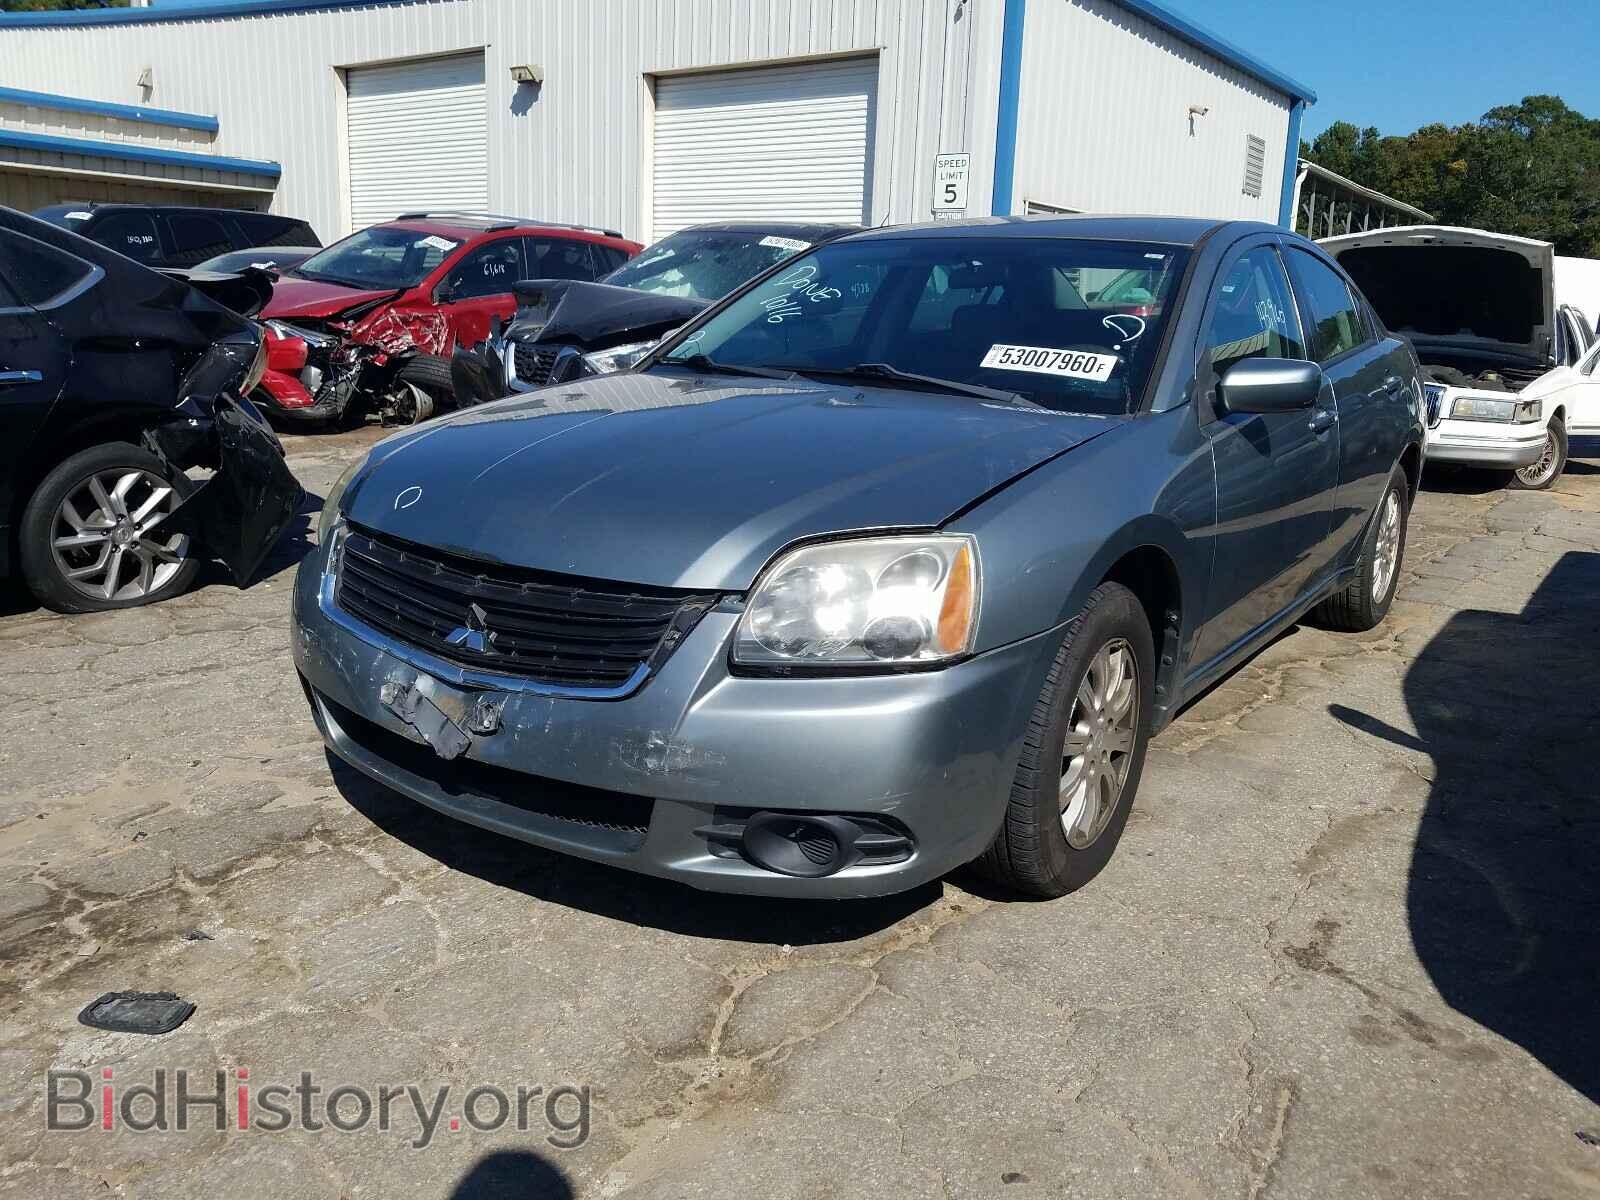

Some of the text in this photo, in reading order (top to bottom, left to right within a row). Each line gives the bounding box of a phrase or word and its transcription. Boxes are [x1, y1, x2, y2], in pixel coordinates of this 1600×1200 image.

[938, 159, 967, 168] SPEED
[940, 171, 964, 181] LIMIT
[944, 183, 957, 204] 5
[998, 347, 1106, 374] 53007960 F
